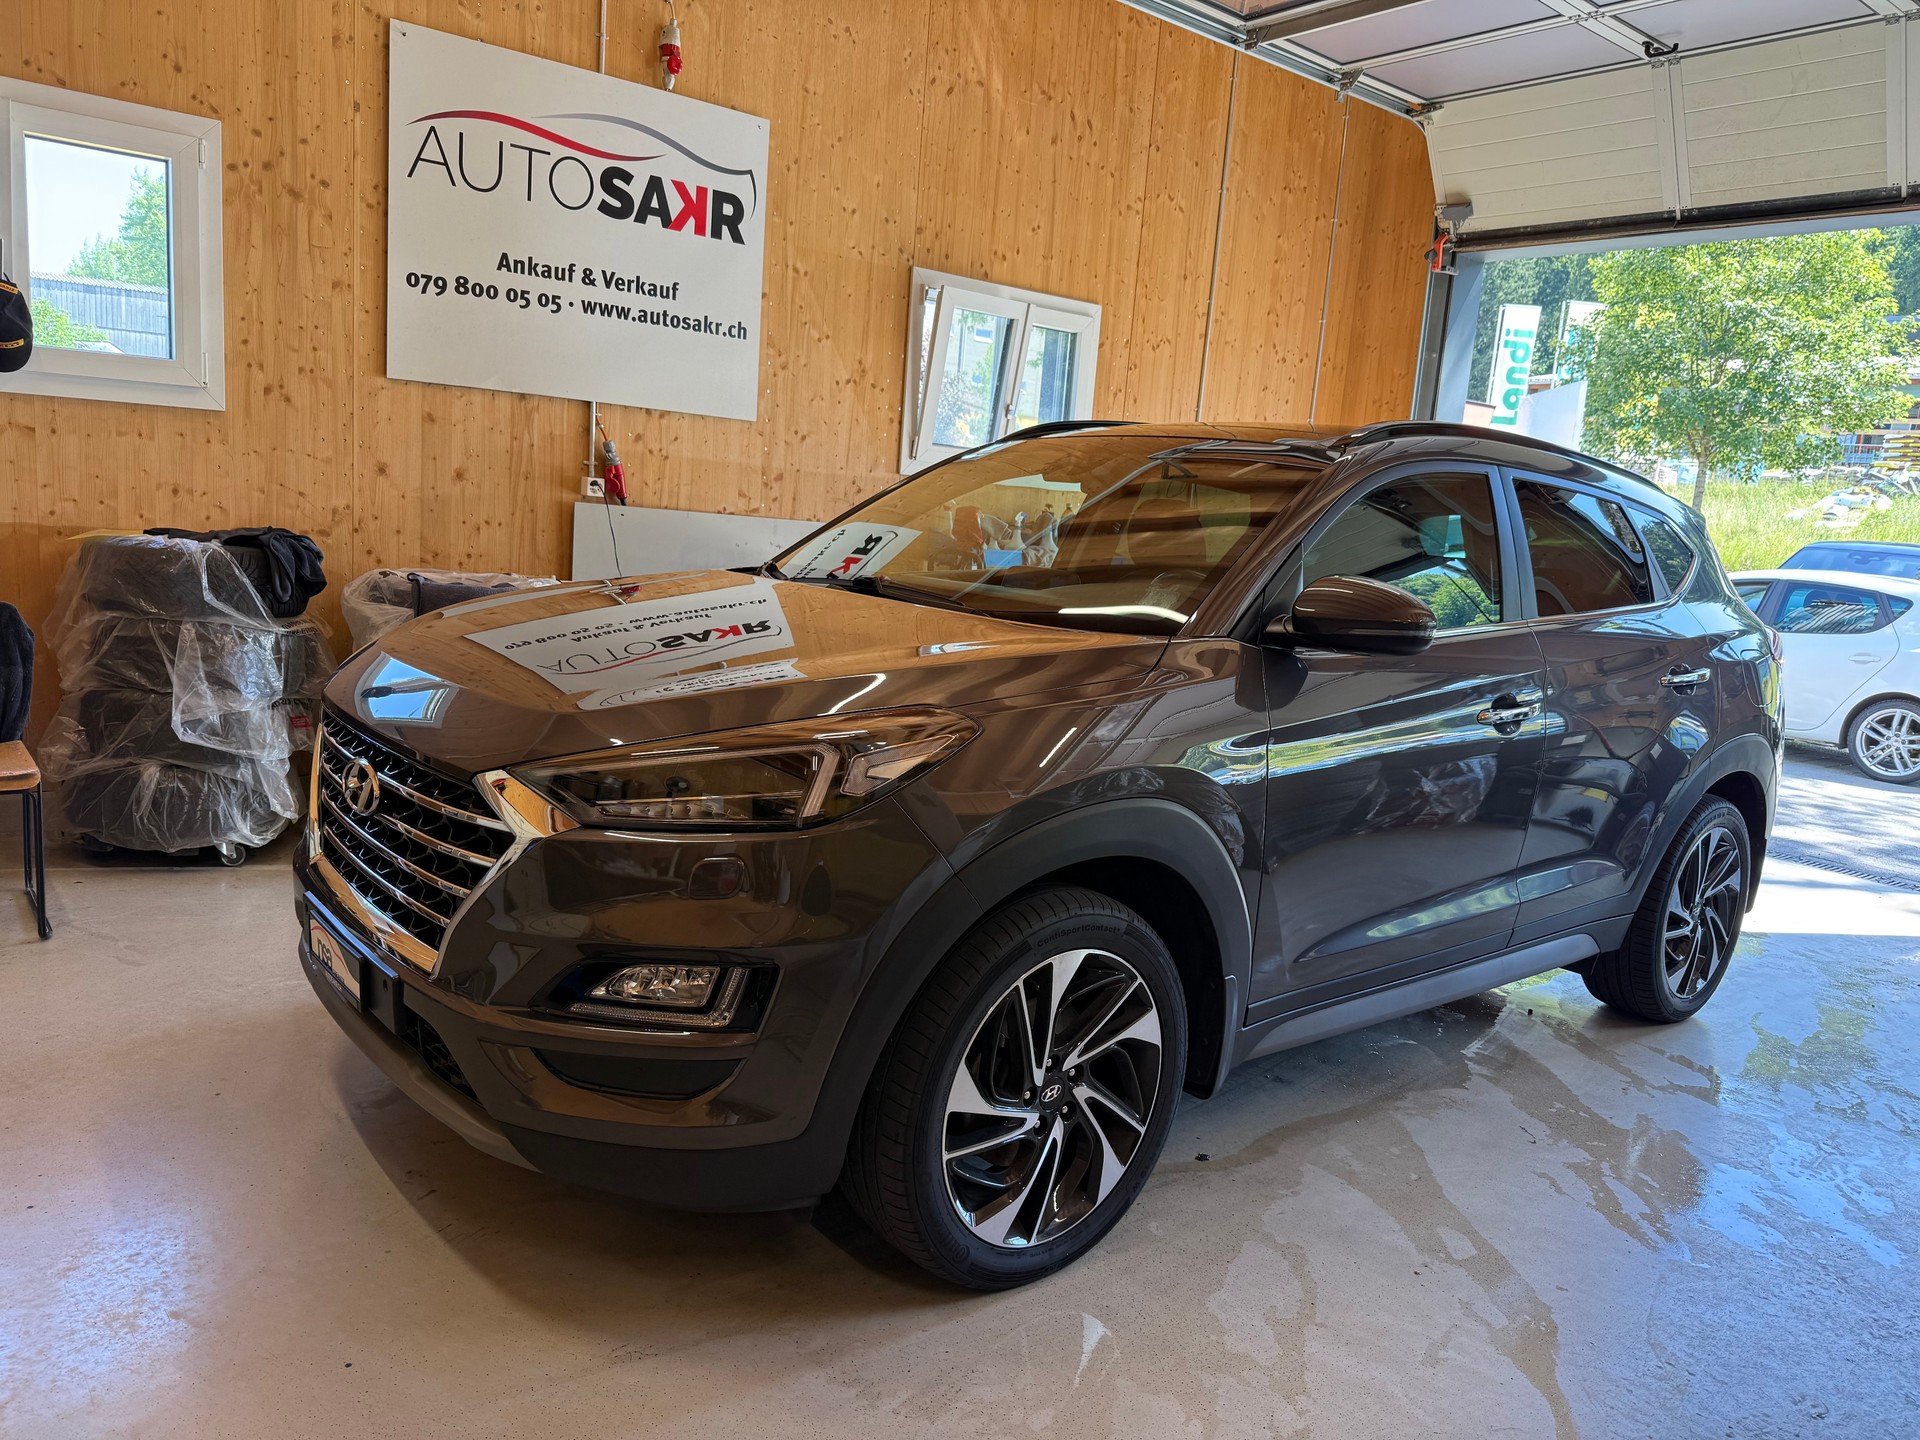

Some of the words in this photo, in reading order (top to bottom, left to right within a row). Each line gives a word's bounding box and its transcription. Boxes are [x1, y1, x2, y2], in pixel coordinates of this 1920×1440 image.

[407, 125, 745, 245] AUTOSAKR
[405, 270, 448, 296] 079
[454, 275, 499, 300] 800
[505, 288, 531, 309] 05
[537, 293, 562, 314] 05
[581, 300, 748, 341] www.autosakr.ch
[496, 252, 576, 284] Ankauf
[581, 267, 598, 287] &
[602, 269, 680, 301] Verkauf
[1491, 328, 1535, 426] Landi
